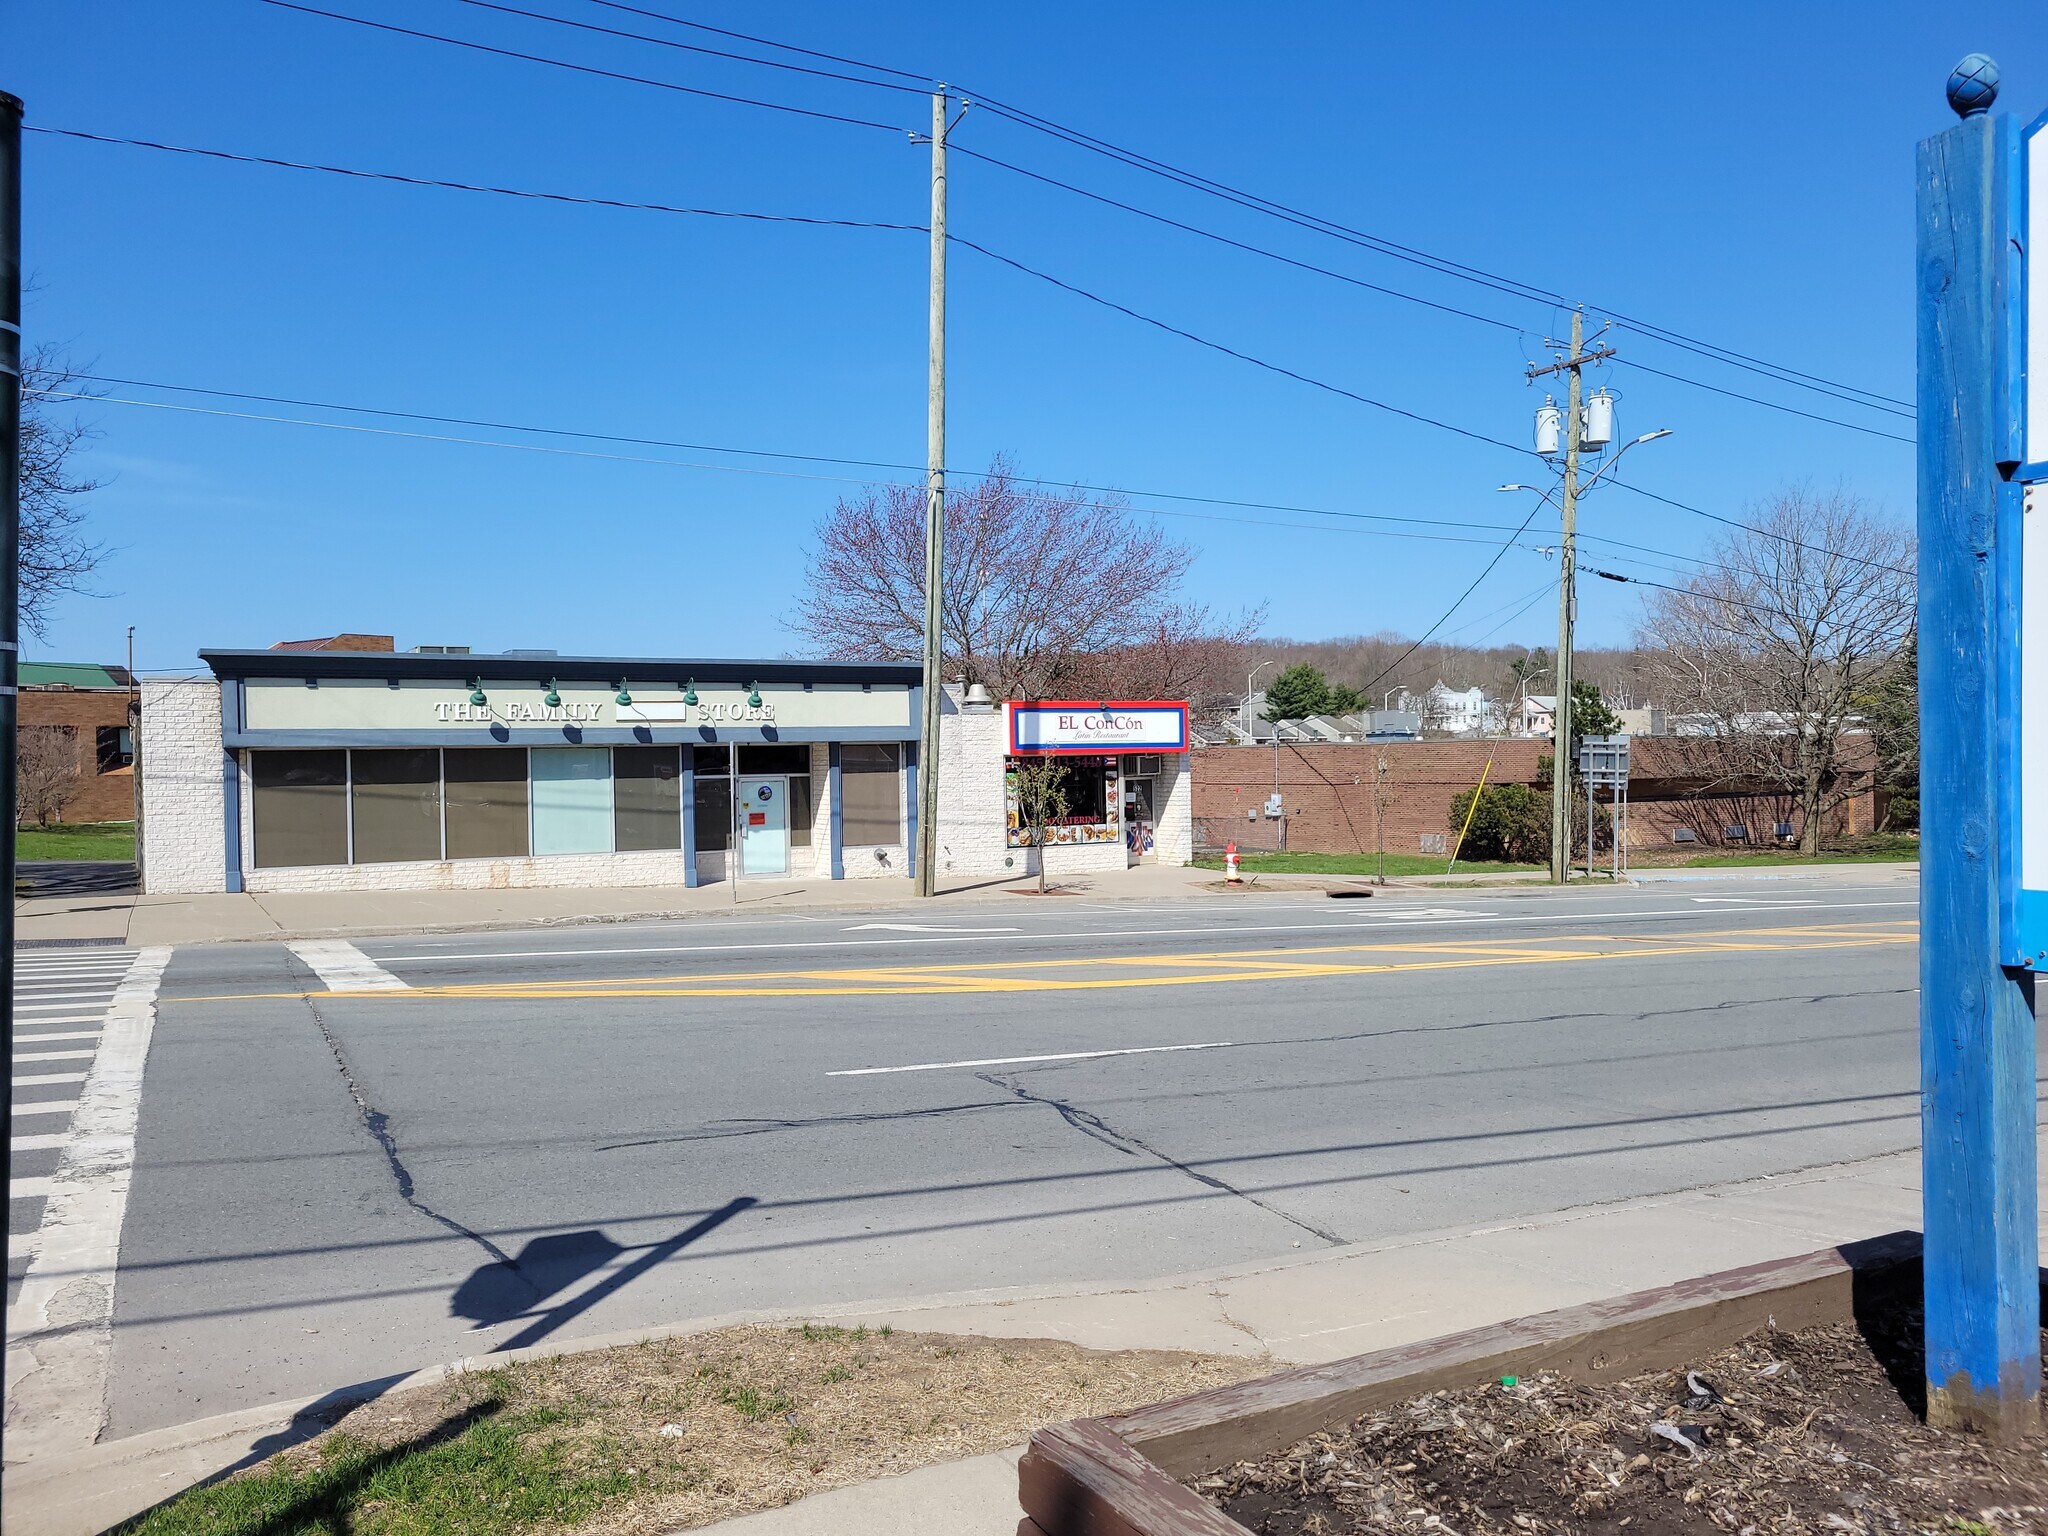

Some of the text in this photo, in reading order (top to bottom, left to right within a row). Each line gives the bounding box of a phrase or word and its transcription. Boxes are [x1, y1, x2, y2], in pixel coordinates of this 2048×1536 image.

[434, 702, 775, 721] THE FAMILY STORE
[1058, 716, 1143, 730] EL ConCón
[1073, 730, 1129, 739] Latin Restaurant
[1056, 815, 1100, 825] CATERING
